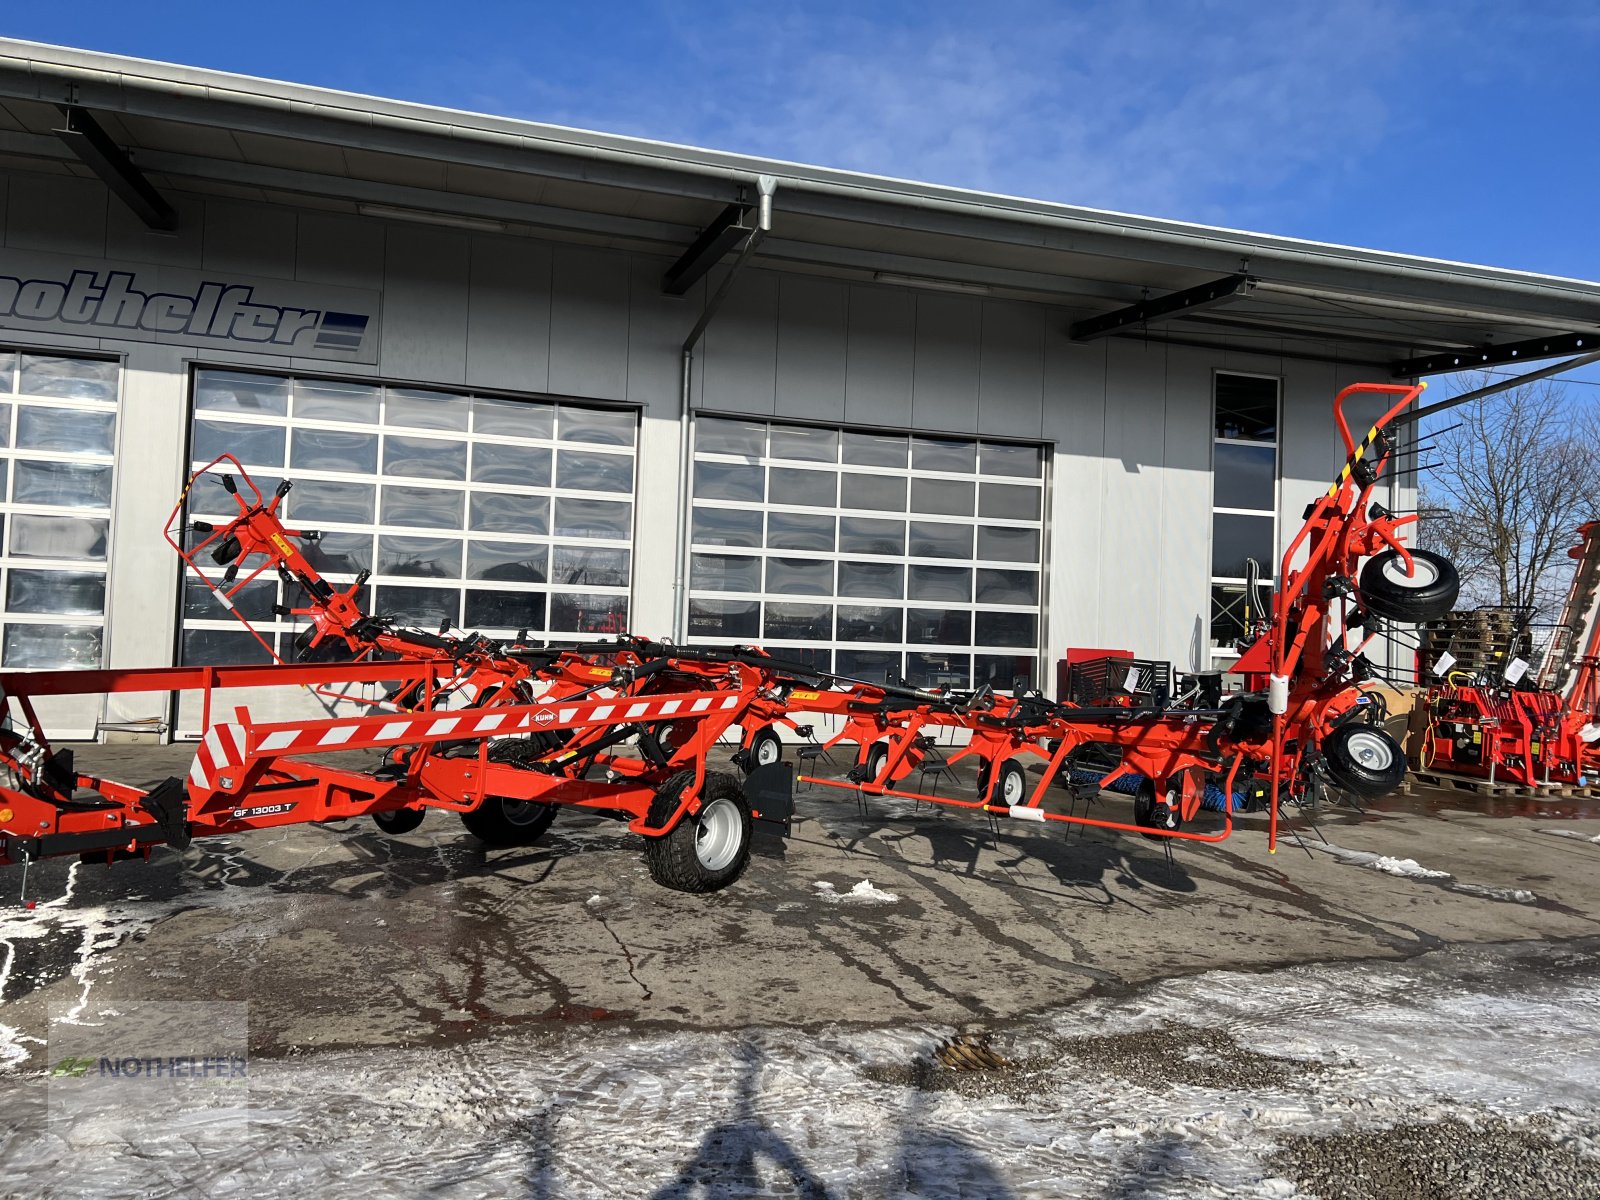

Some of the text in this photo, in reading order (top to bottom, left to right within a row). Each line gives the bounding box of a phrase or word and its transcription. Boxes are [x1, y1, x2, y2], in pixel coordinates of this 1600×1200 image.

[535, 714, 554, 722] KUHN
[233, 803, 292, 817] GF 13003 T
